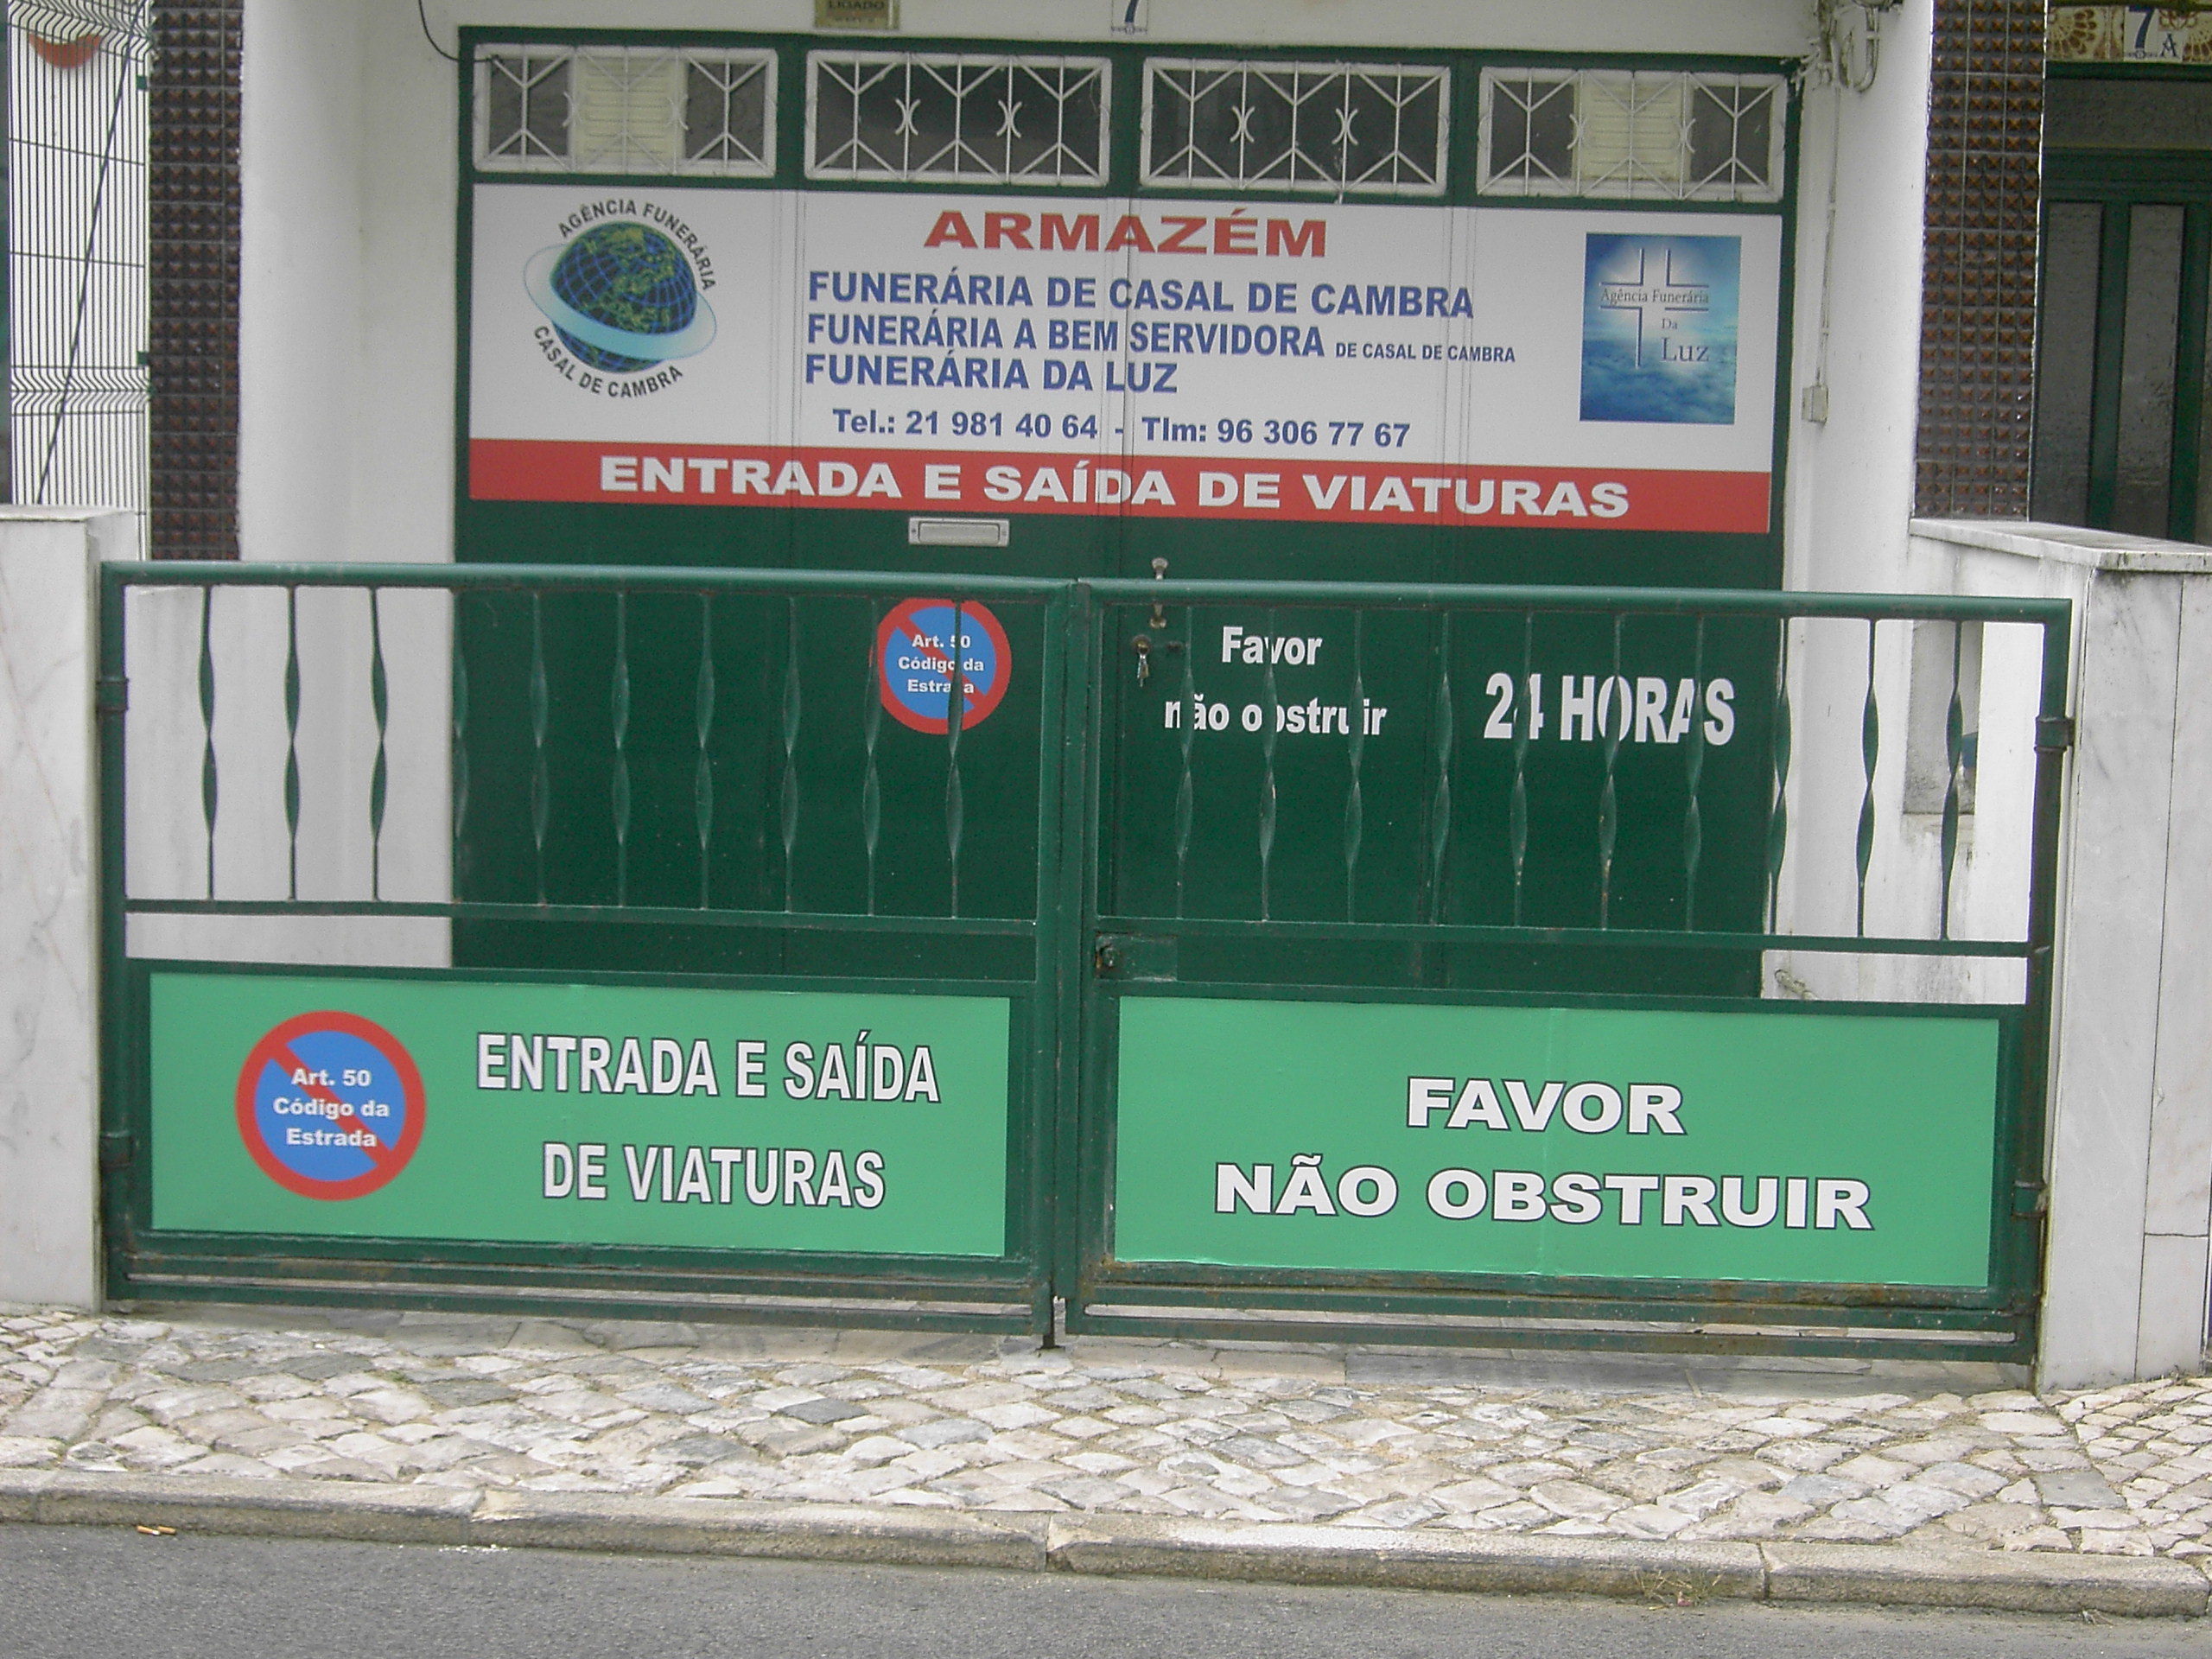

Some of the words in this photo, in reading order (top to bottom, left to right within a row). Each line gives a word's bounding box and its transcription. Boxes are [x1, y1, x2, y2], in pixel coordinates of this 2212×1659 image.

[2128, 7, 2154, 49] 7
[2160, 33, 2177, 58] A
[558, 199, 637, 238] AGÊNCIA
[642, 203, 716, 291] FUNERÁRIA
[924, 208, 1327, 258] ARMAZÉM
[808, 266, 1034, 308] FUNERÁRIA
[1046, 276, 1097, 309] DE
[1108, 278, 1235, 312] CASAL
[1247, 281, 1298, 315] DE
[1310, 283, 1474, 319] CAMBRA
[1599, 287, 1649, 306] Agência
[1651, 289, 1710, 305] Funerária
[807, 308, 1004, 349] FUNERÁRIA
[1013, 318, 1037, 350] A
[1048, 320, 1119, 352] BEM
[1128, 322, 1325, 358] SERVIDORA
[1334, 342, 1358, 359] DE
[1361, 342, 1417, 362] CASAL
[1421, 344, 1443, 363] DE
[1446, 346, 1517, 365] CAMBRA
[1661, 316, 1679, 331] Da
[533, 325, 574, 381] CASAL
[578, 372, 603, 394] DE
[607, 365, 683, 398] CAMBRA
[804, 349, 1031, 390] FUNERÁRIA
[1043, 360, 1094, 391] DA
[1105, 361, 1178, 394] LUZ
[1661, 336, 1710, 364] Luz
[832, 408, 895, 433] Tel.:
[905, 410, 939, 435] 21
[950, 410, 1002, 437] 981
[1015, 412, 1052, 439] 40
[1061, 414, 1098, 439] 64
[1141, 416, 1207, 442] Tlm:
[1217, 418, 1254, 444] 96
[1263, 419, 1318, 446] 306
[1327, 421, 1365, 447] 77
[1373, 423, 1411, 448] 67
[600, 455, 902, 499] ENTRADA
[924, 464, 962, 501] E
[983, 461, 1176, 506] SAÍDA
[1198, 471, 1281, 509] DE
[1302, 474, 1630, 519] VIATURAS
[912, 634, 944, 649] Art.
[963, 658, 985, 671] da
[1220, 625, 1324, 666] Favor
[907, 678, 975, 694] Estraa
[1558, 673, 1736, 747] HORAS
[290, 1066, 336, 1087] Art.
[342, 1068, 372, 1087] 50
[475, 1030, 719, 1097] ENTRADA
[733, 1039, 769, 1099] E
[780, 1028, 942, 1104] SAÍDA
[272, 1096, 355, 1121] Código
[359, 1099, 391, 1117] da
[1405, 1076, 1687, 1136] FAVOR
[285, 1127, 378, 1147] Estrada
[541, 1141, 608, 1201] DE
[620, 1142, 887, 1210] VIATURAS
[1213, 1153, 1400, 1218] NÃO
[1425, 1166, 1877, 1232] OBSTRUIR
